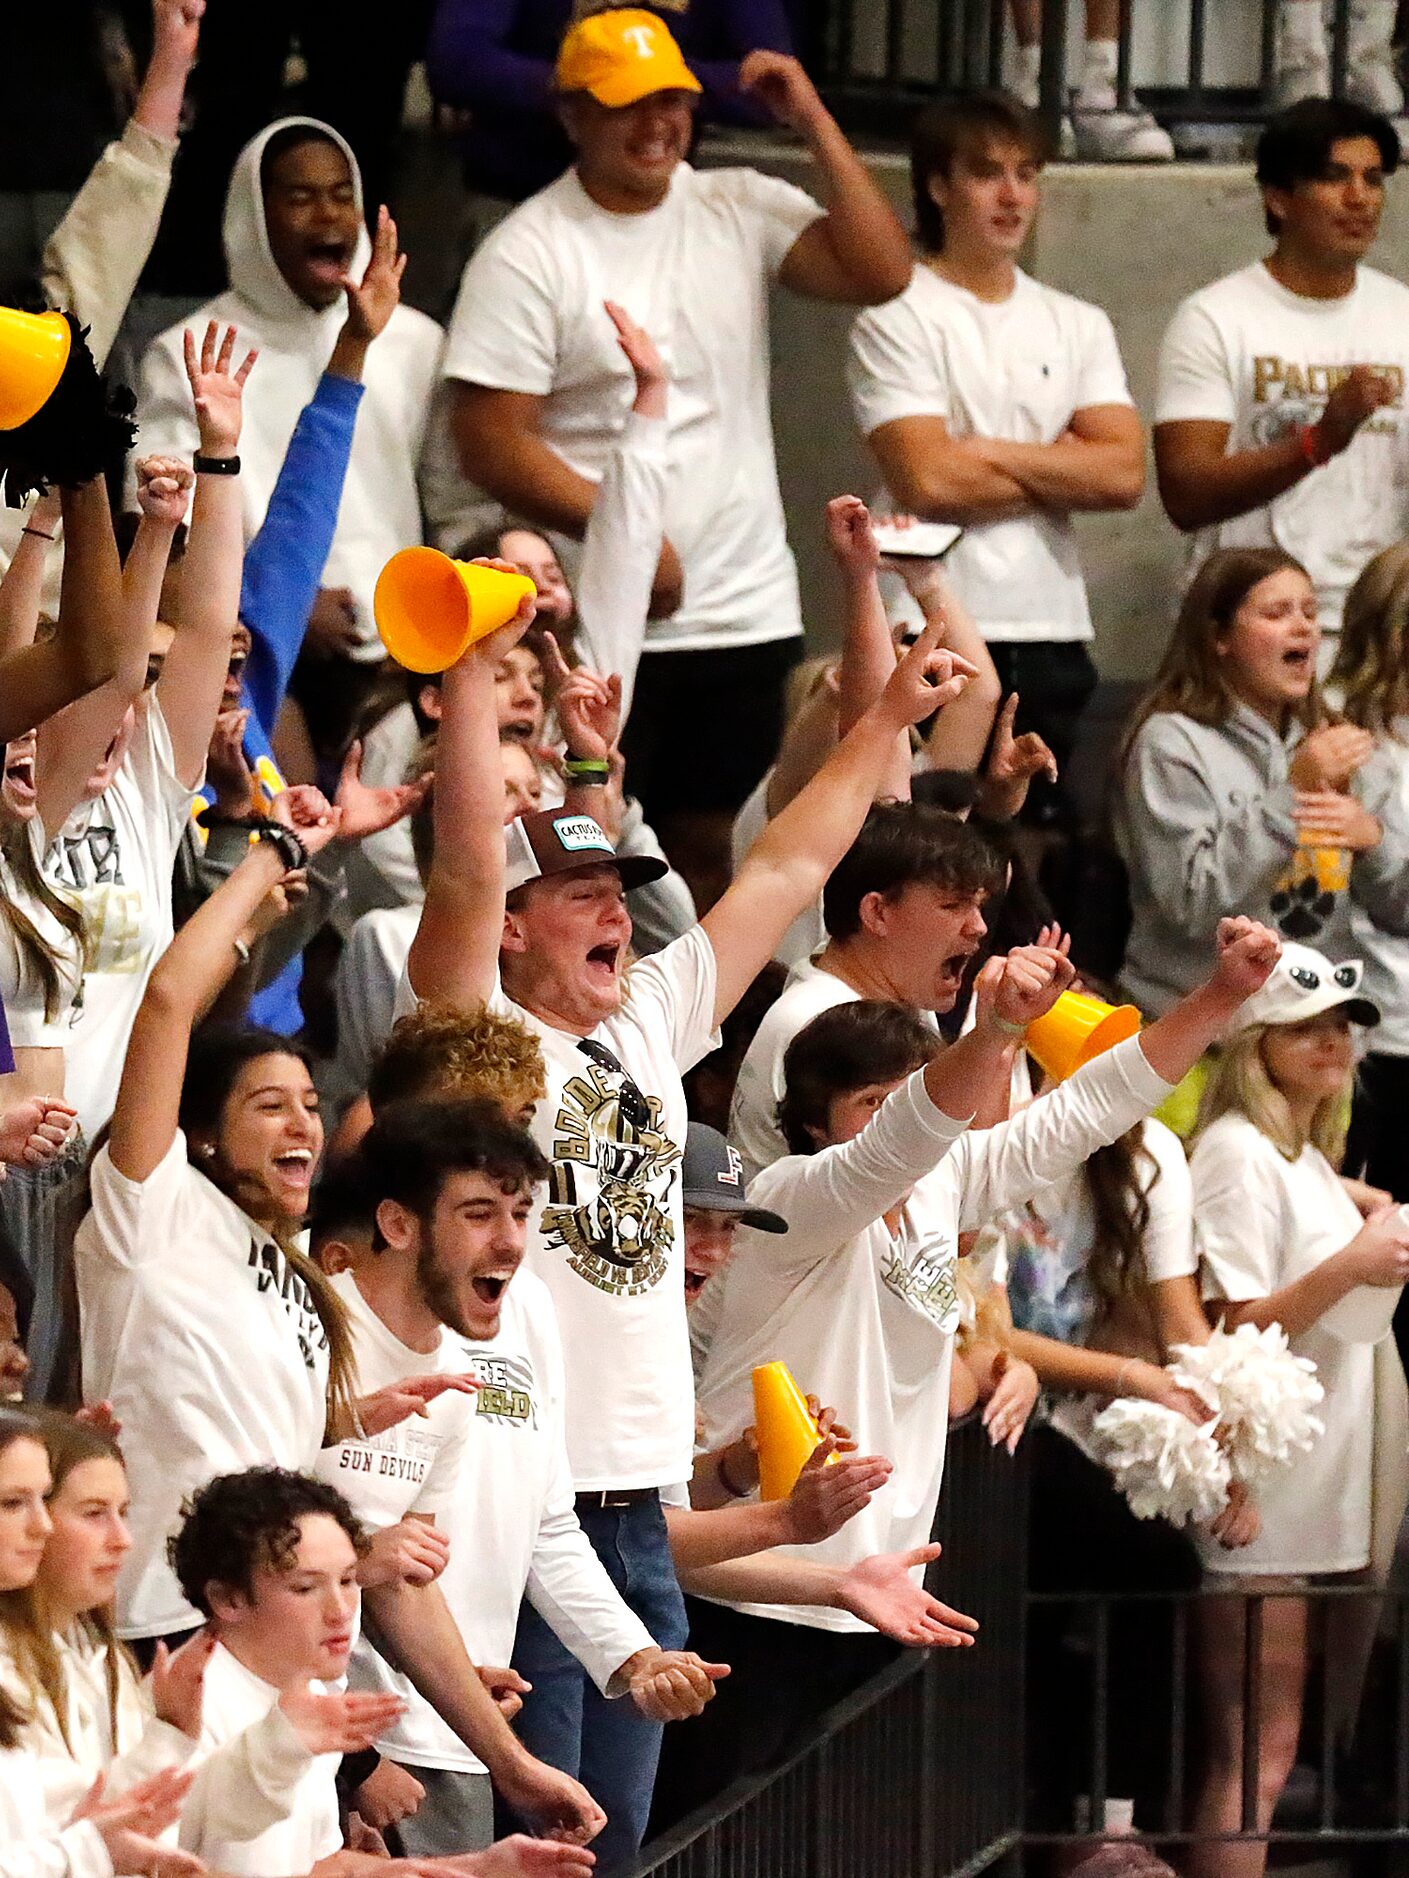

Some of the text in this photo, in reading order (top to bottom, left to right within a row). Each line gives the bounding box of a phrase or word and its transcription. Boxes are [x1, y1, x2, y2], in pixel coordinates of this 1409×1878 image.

[623, 26, 654, 58] T
[561, 823, 593, 837] CACTUS
[339, 1449, 425, 1484] SUN DEVILS
